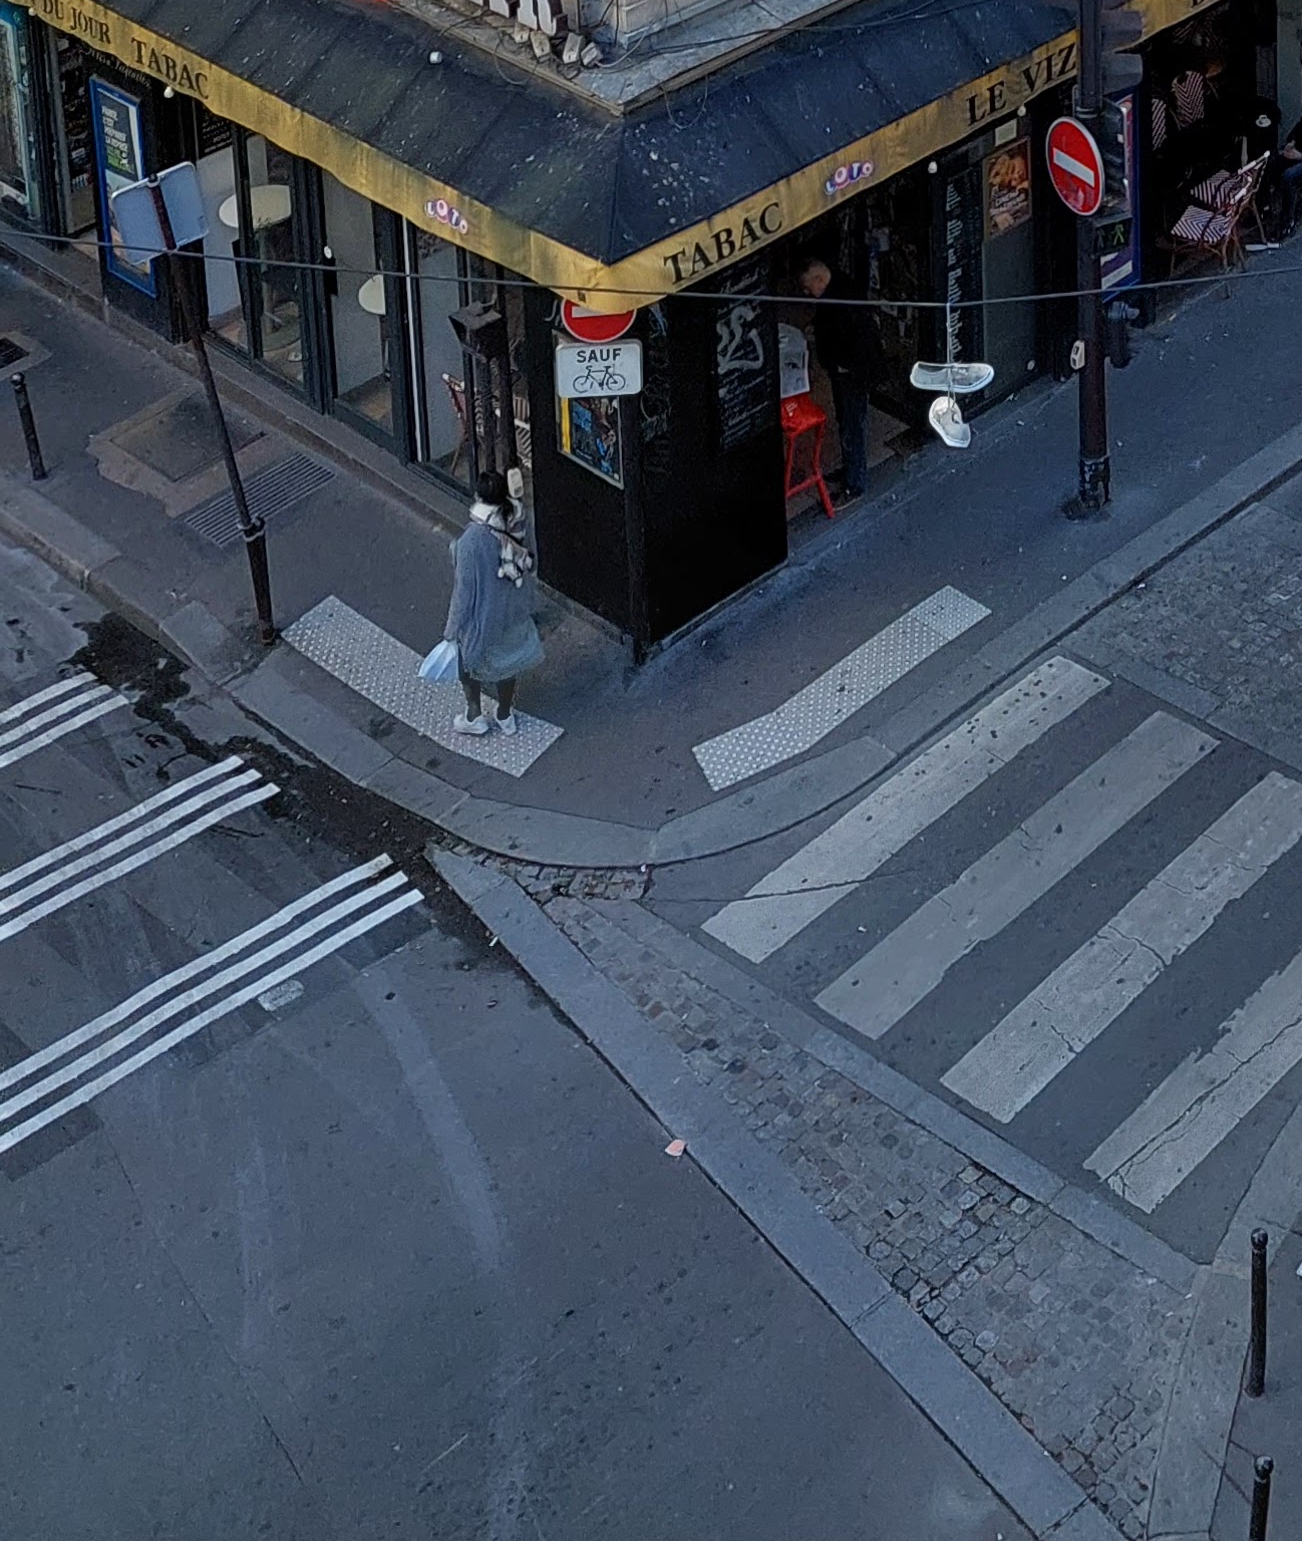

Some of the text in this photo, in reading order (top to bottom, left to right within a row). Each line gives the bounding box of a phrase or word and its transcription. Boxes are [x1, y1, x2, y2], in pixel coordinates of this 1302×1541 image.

[71, 7, 111, 44] JOUR
[131, 37, 208, 100] TABAC
[966, 42, 1077, 126] LE VIZ
[824, 160, 874, 195] LOTO
[425, 199, 468, 234] LOTO
[663, 202, 783, 286] TABAC
[577, 348, 621, 363] SAUF
